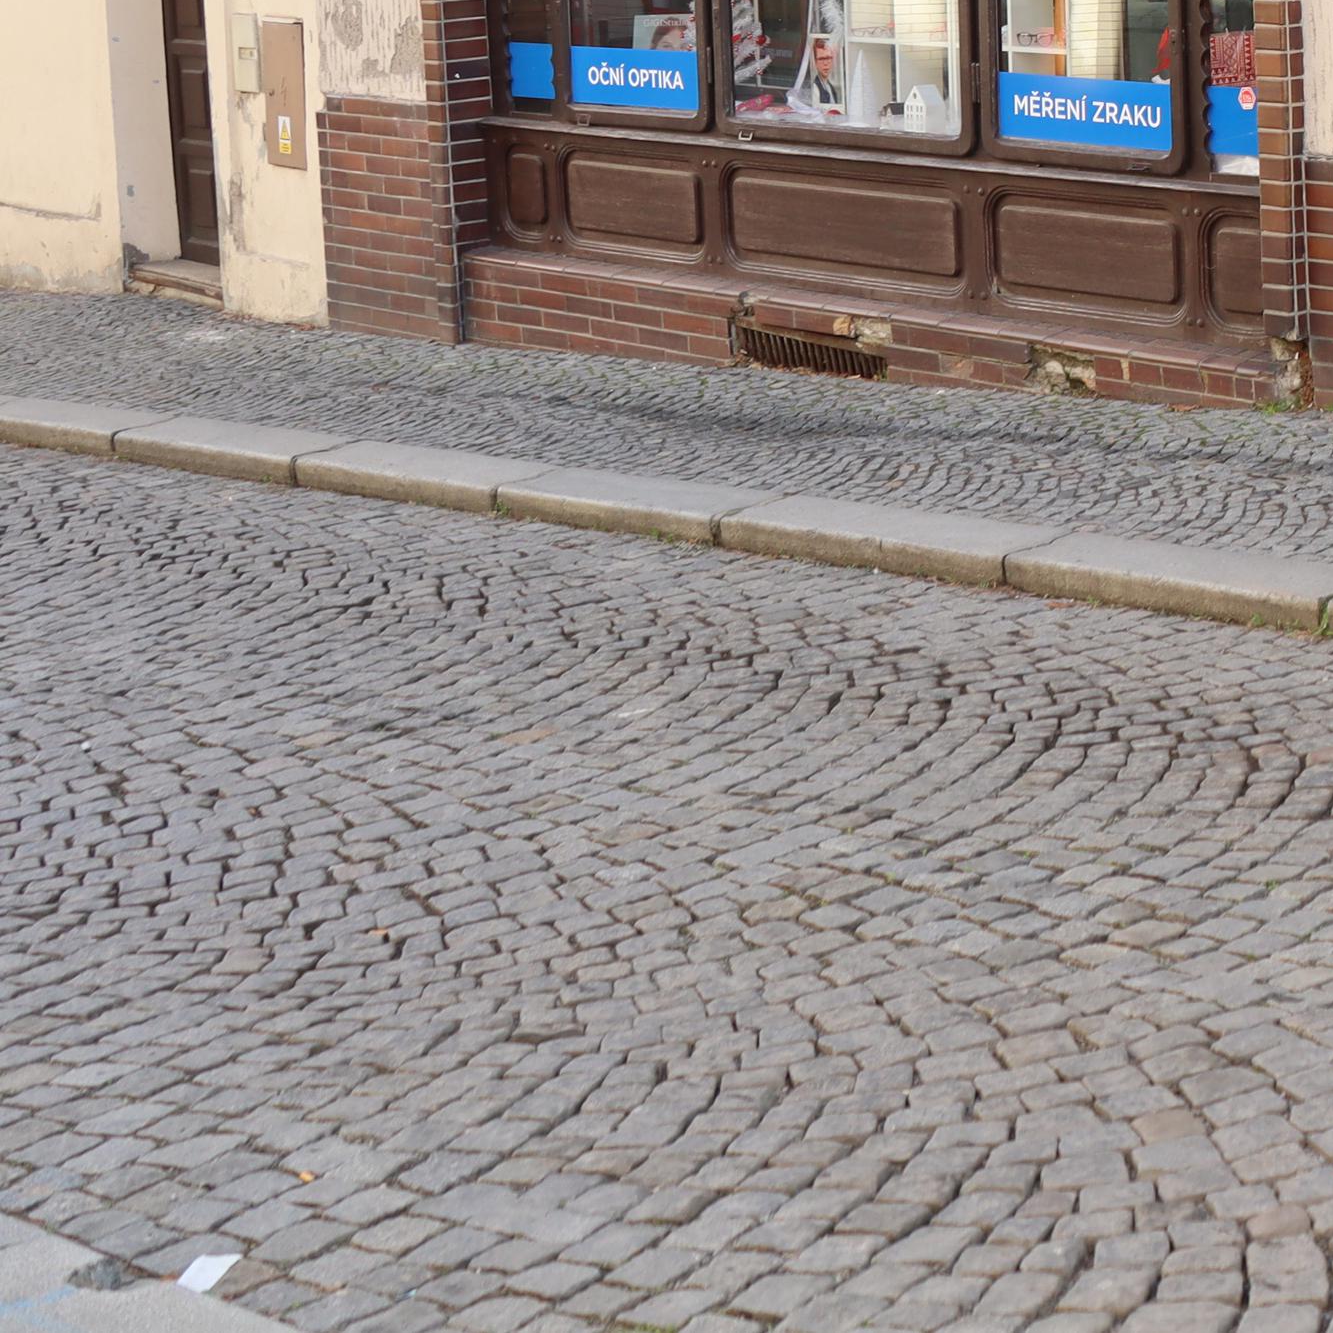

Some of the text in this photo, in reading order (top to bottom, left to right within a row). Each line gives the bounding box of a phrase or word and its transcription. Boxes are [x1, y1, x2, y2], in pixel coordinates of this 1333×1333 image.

[588, 62, 684, 90] OČNÍ OPTIKA
[1013, 90, 1161, 128] MĚŘENÍ ZRAKU
